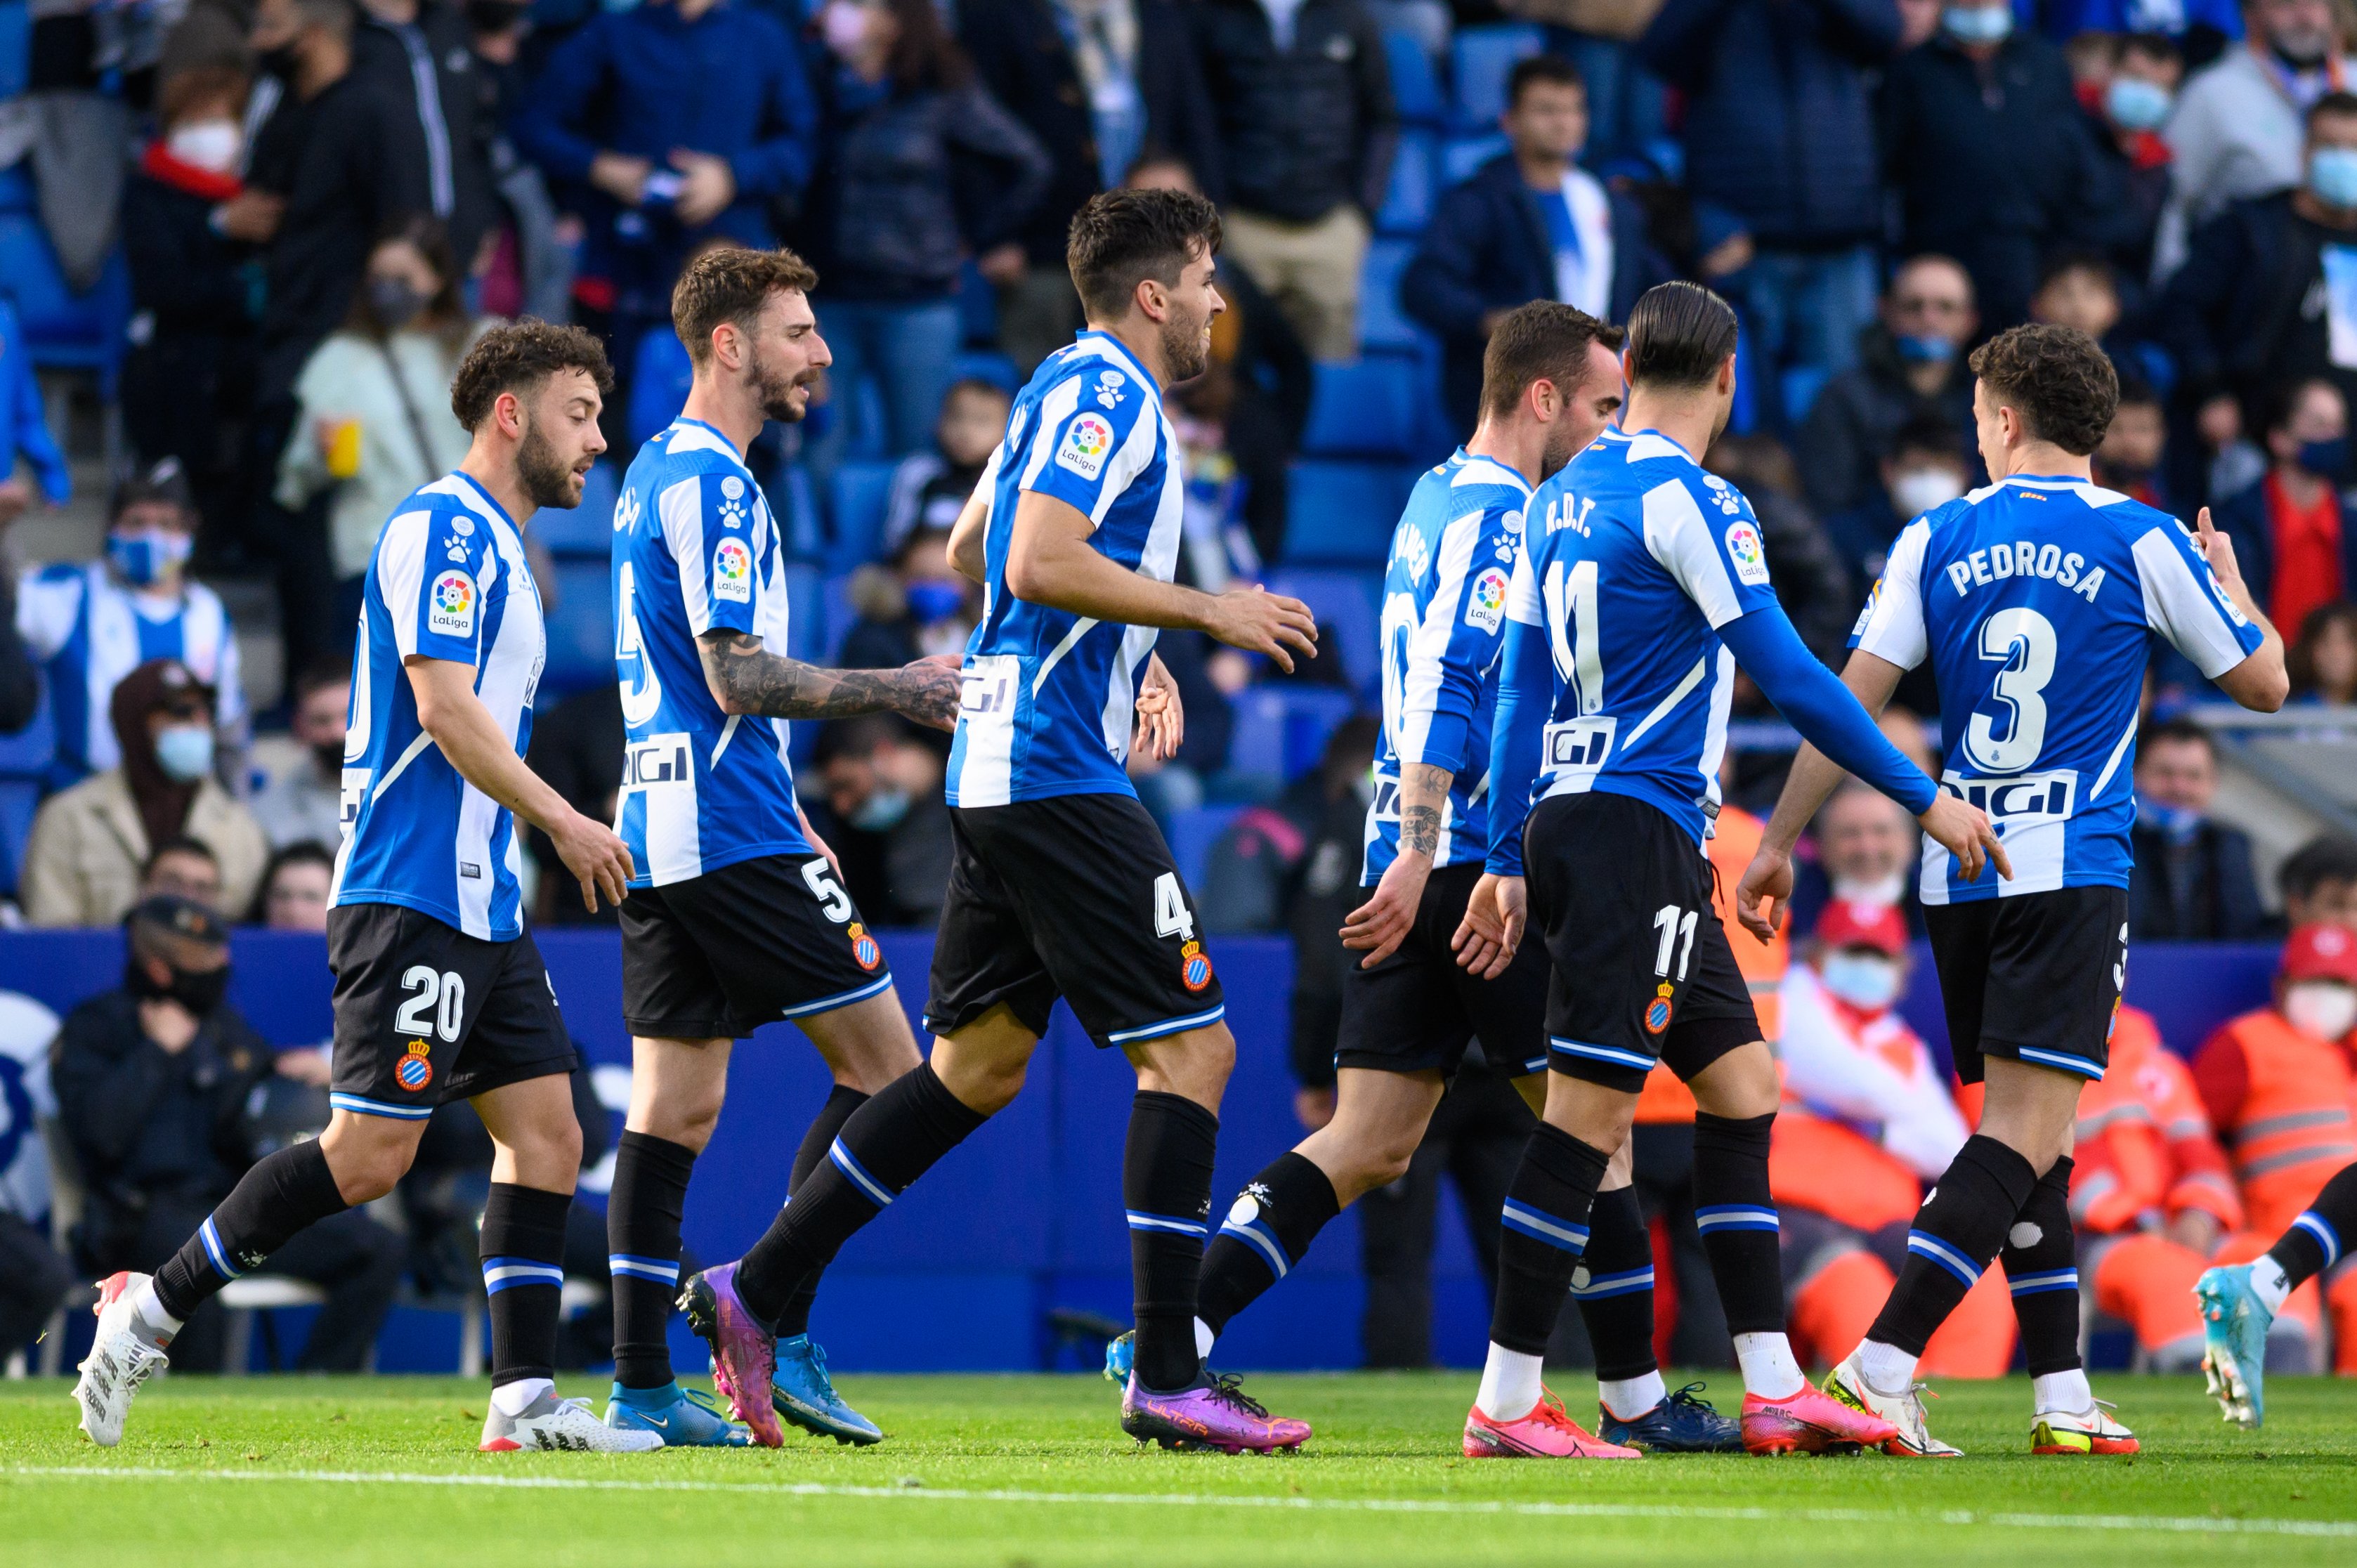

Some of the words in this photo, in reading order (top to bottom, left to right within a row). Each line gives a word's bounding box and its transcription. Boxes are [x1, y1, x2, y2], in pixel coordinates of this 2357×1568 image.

[1062, 449, 1096, 471] LaLiga
[1546, 492, 1596, 538] R.D.T.
[717, 581, 746, 594] LaLiga
[1947, 541, 2106, 603] PEDROSA
[433, 615, 468, 629] LaLiga
[615, 561, 661, 729] 5
[1470, 609, 1497, 626] LaLiga
[1543, 560, 1604, 717] 11
[1962, 607, 2057, 774] 3
[801, 856, 851, 923] 5
[1154, 871, 1194, 941] 4
[1654, 904, 1698, 982] 11
[395, 965, 465, 1043] 20
[1147, 1399, 1208, 1437] ULTRA
